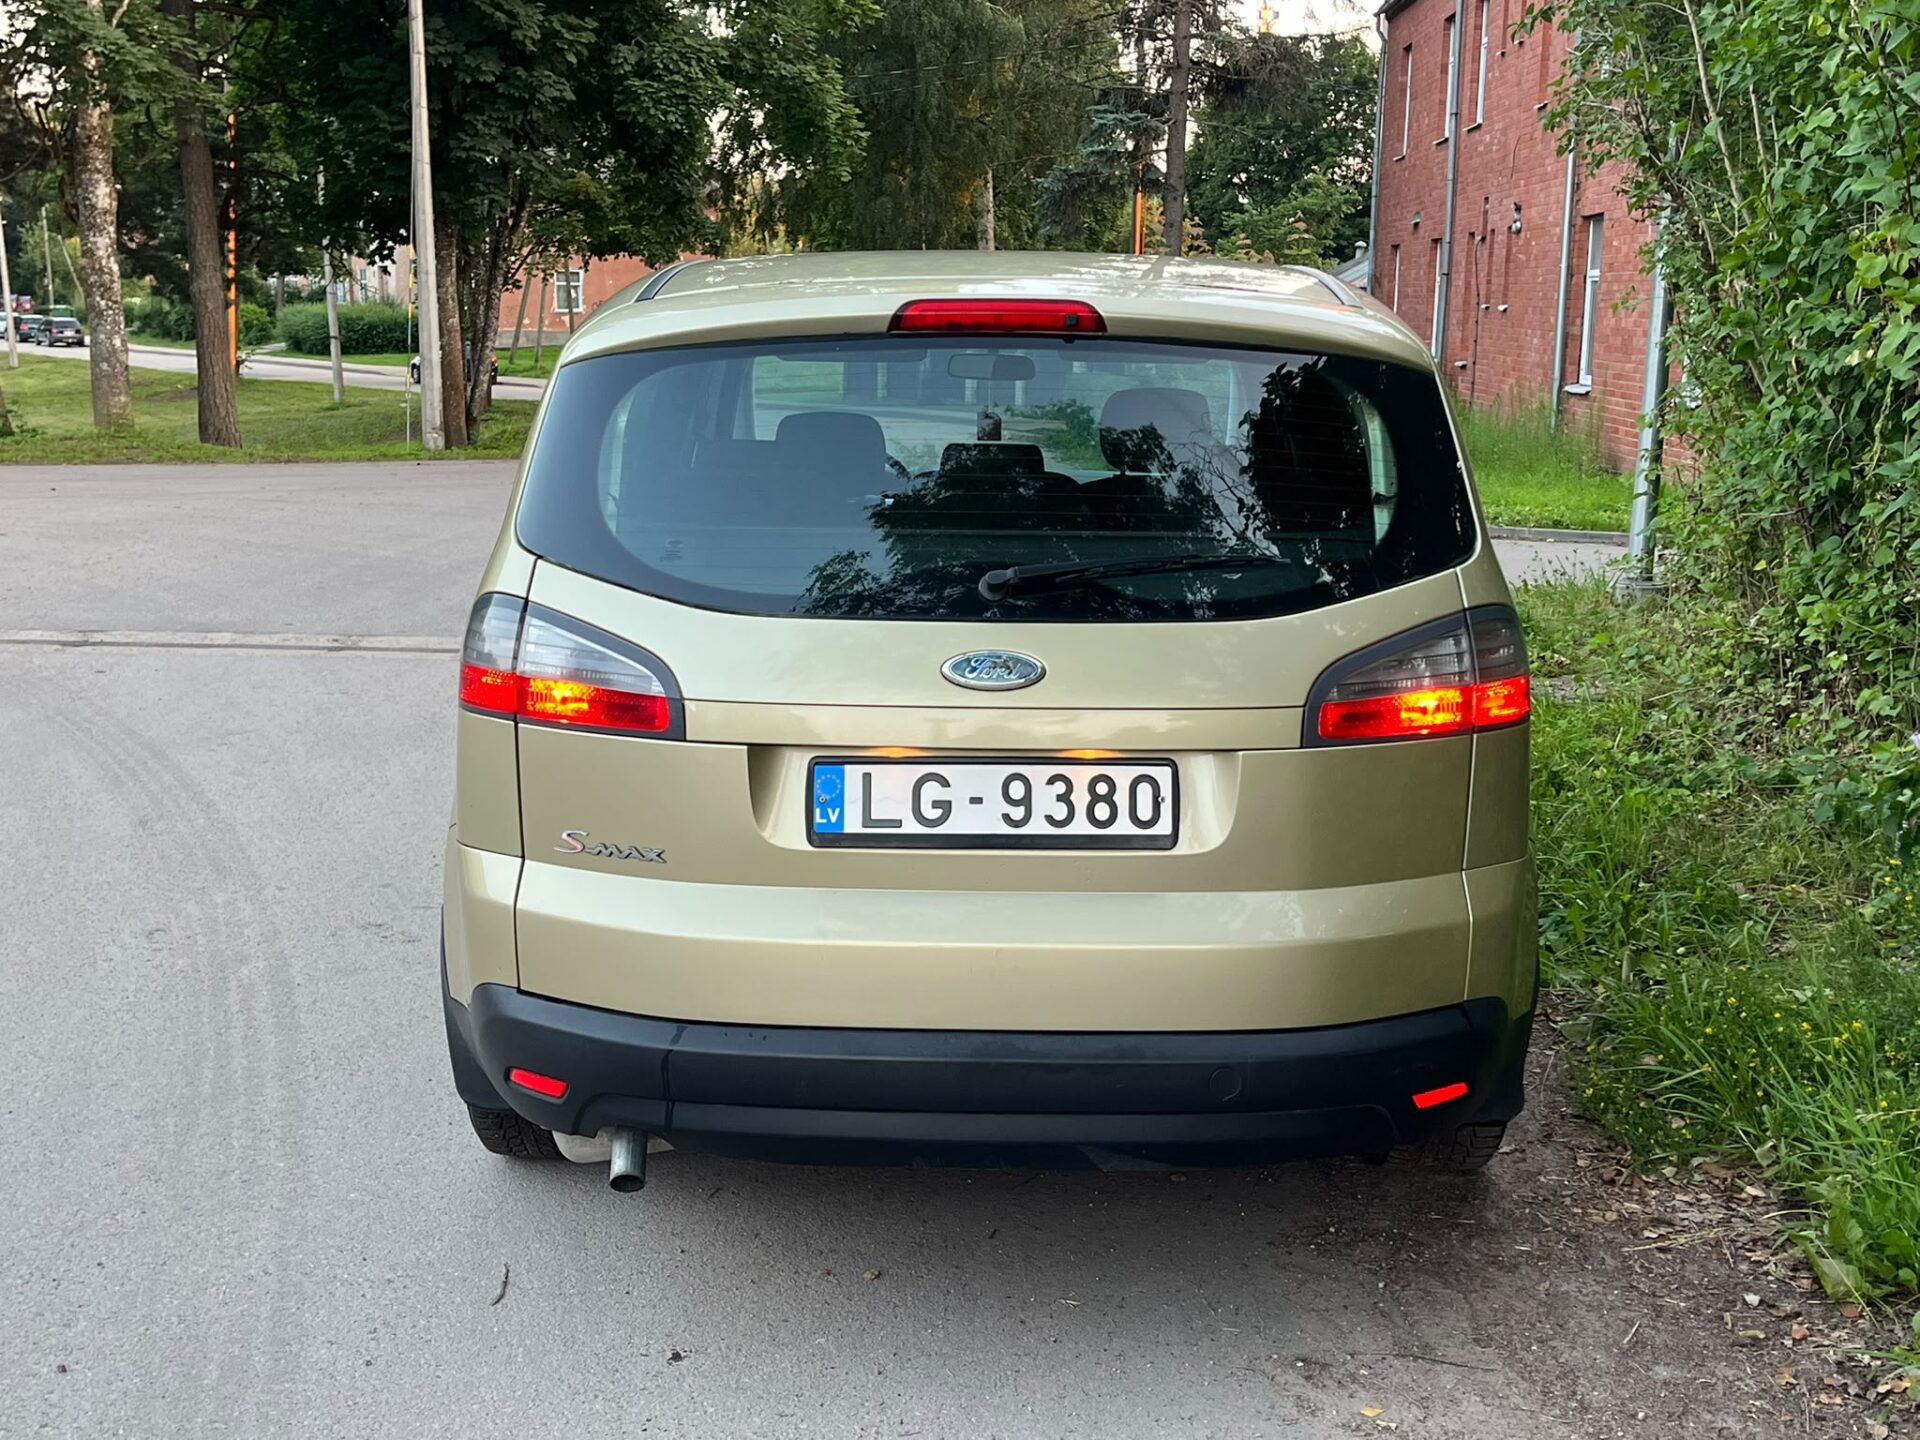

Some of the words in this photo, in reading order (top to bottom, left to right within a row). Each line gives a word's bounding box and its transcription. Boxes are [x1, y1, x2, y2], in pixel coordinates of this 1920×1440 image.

[965, 656, 1020, 679] Ford
[861, 771, 1162, 830] LG-9380
[815, 807, 840, 823] LV
